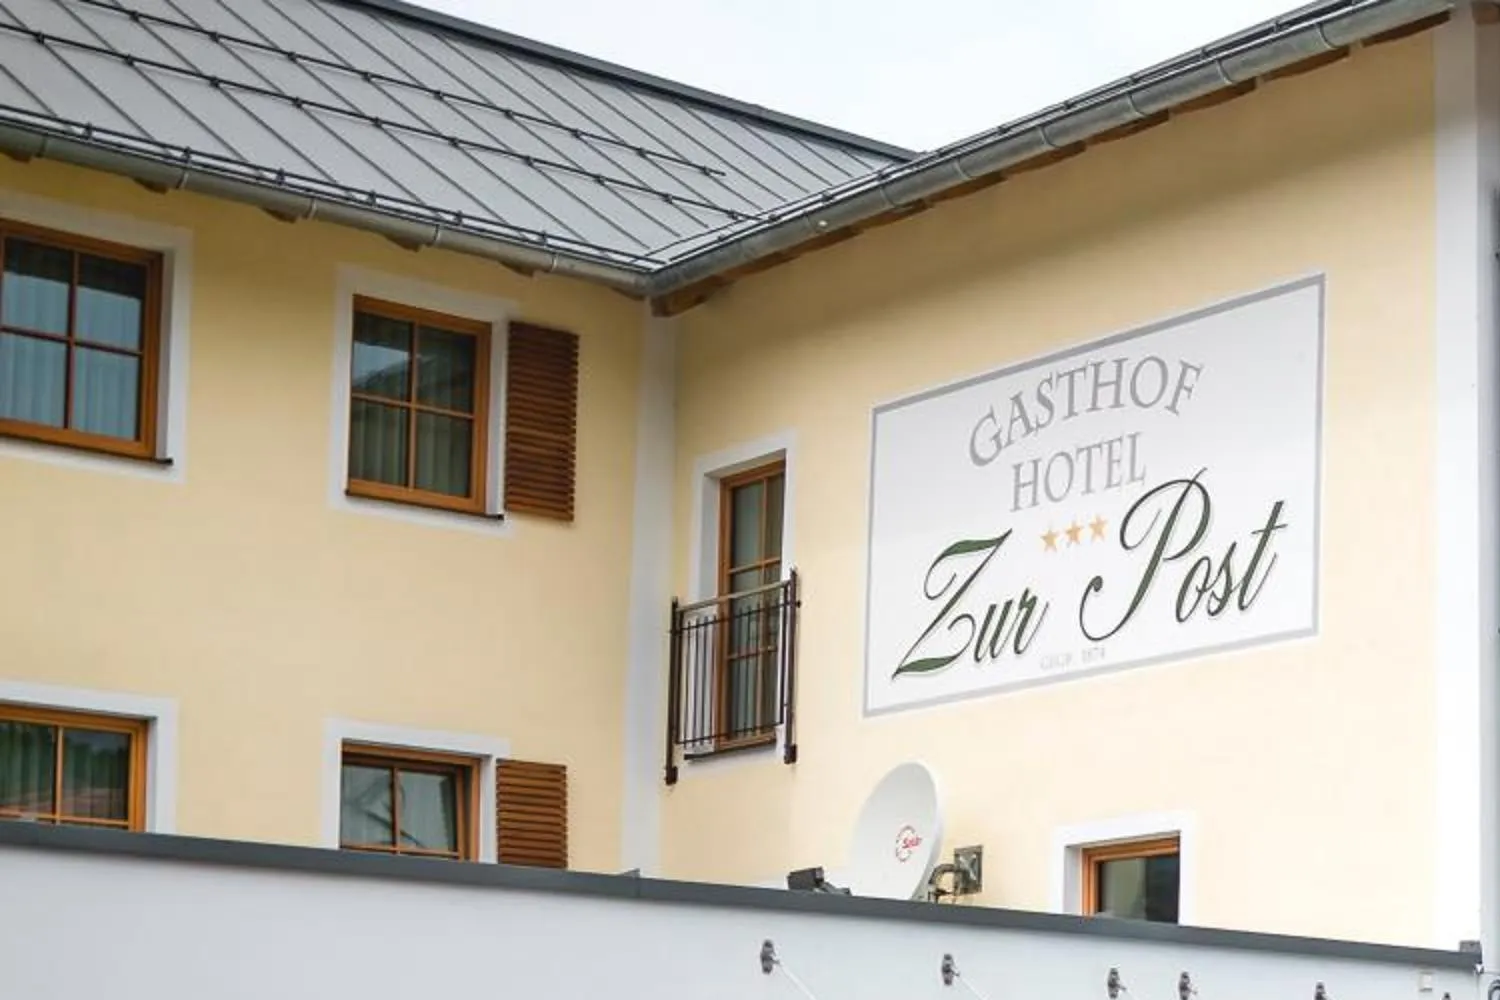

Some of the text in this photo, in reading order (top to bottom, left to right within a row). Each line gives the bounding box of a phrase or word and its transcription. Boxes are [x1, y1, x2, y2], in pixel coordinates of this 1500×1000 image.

[968, 355, 1205, 467] GASTHOF
[1009, 431, 1146, 512] HOTEL
[892, 467, 1289, 680] Zur Post
